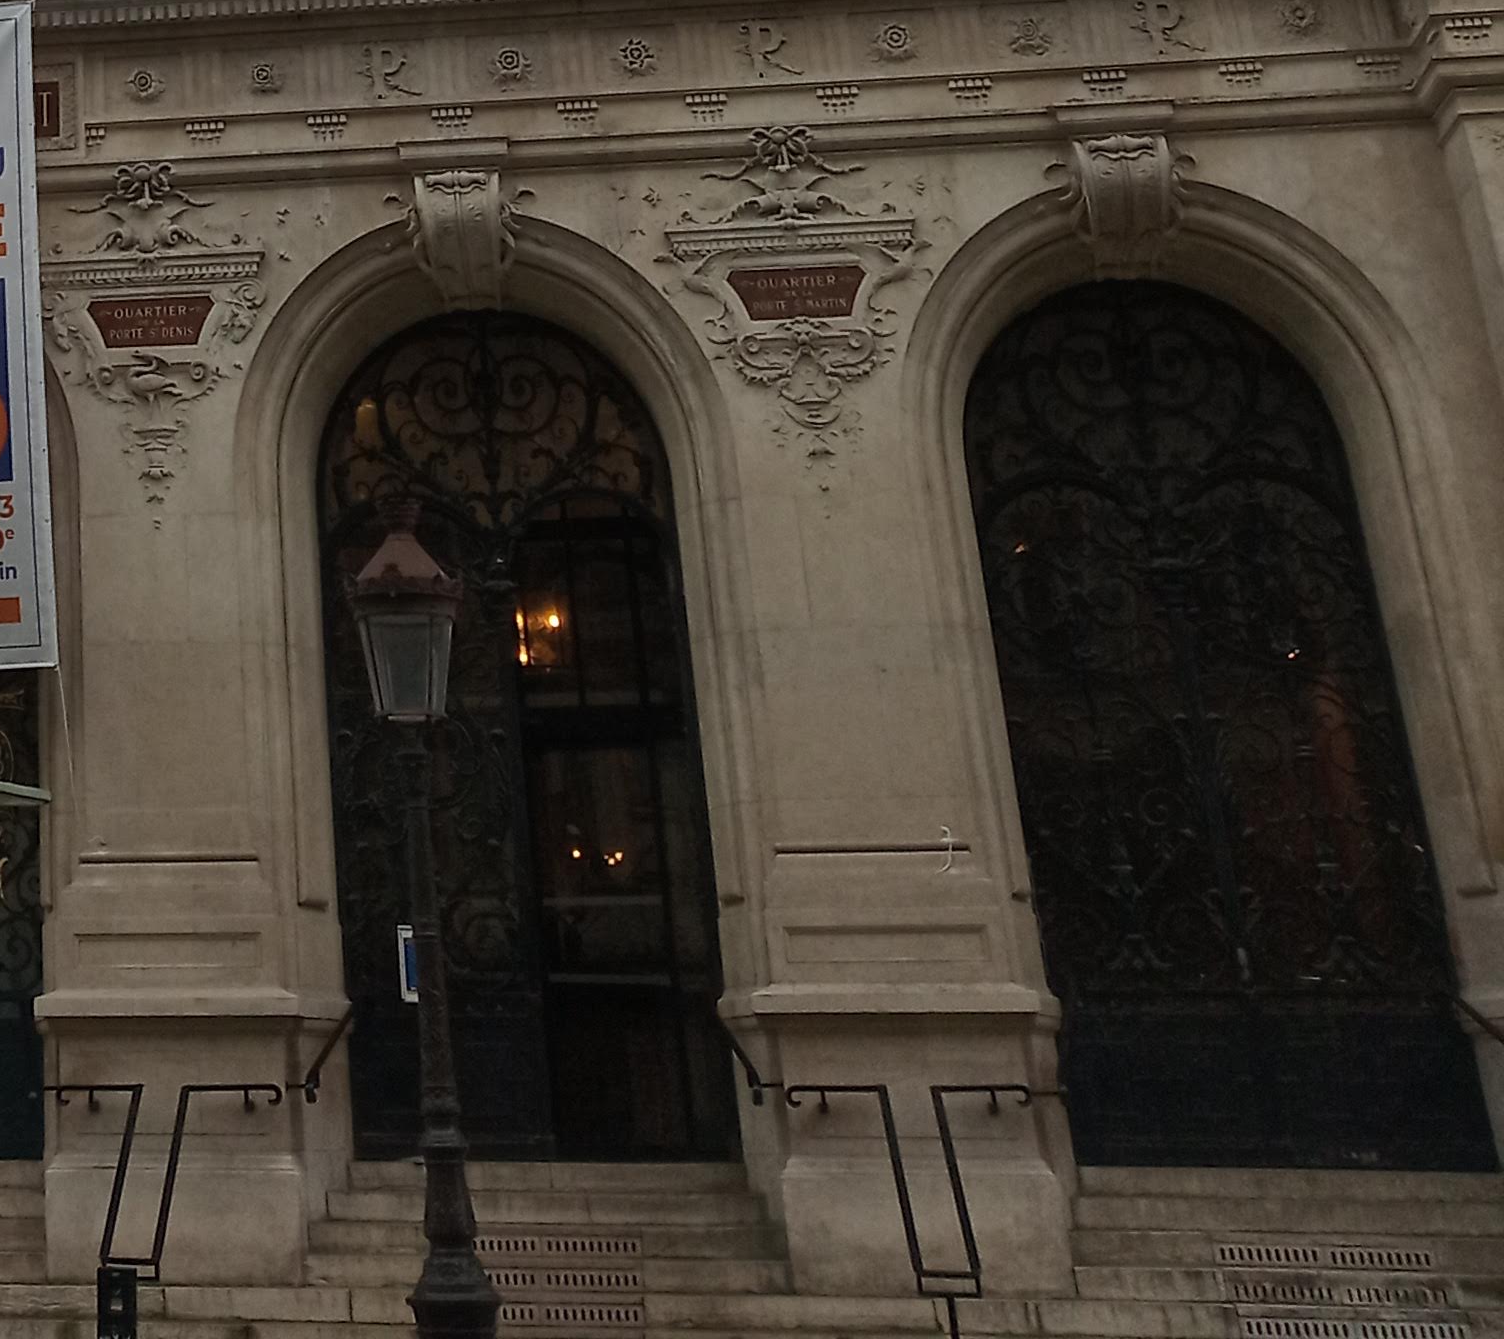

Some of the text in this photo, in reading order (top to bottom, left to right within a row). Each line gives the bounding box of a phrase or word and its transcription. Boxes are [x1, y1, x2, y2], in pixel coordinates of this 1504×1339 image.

[757, 274, 837, 289] QUARTIER
[805, 298, 847, 308] MARTIN
[114, 305, 187, 319] QUARTIER
[109, 328, 144, 340] PORTE
[162, 326, 194, 338] DENIS
